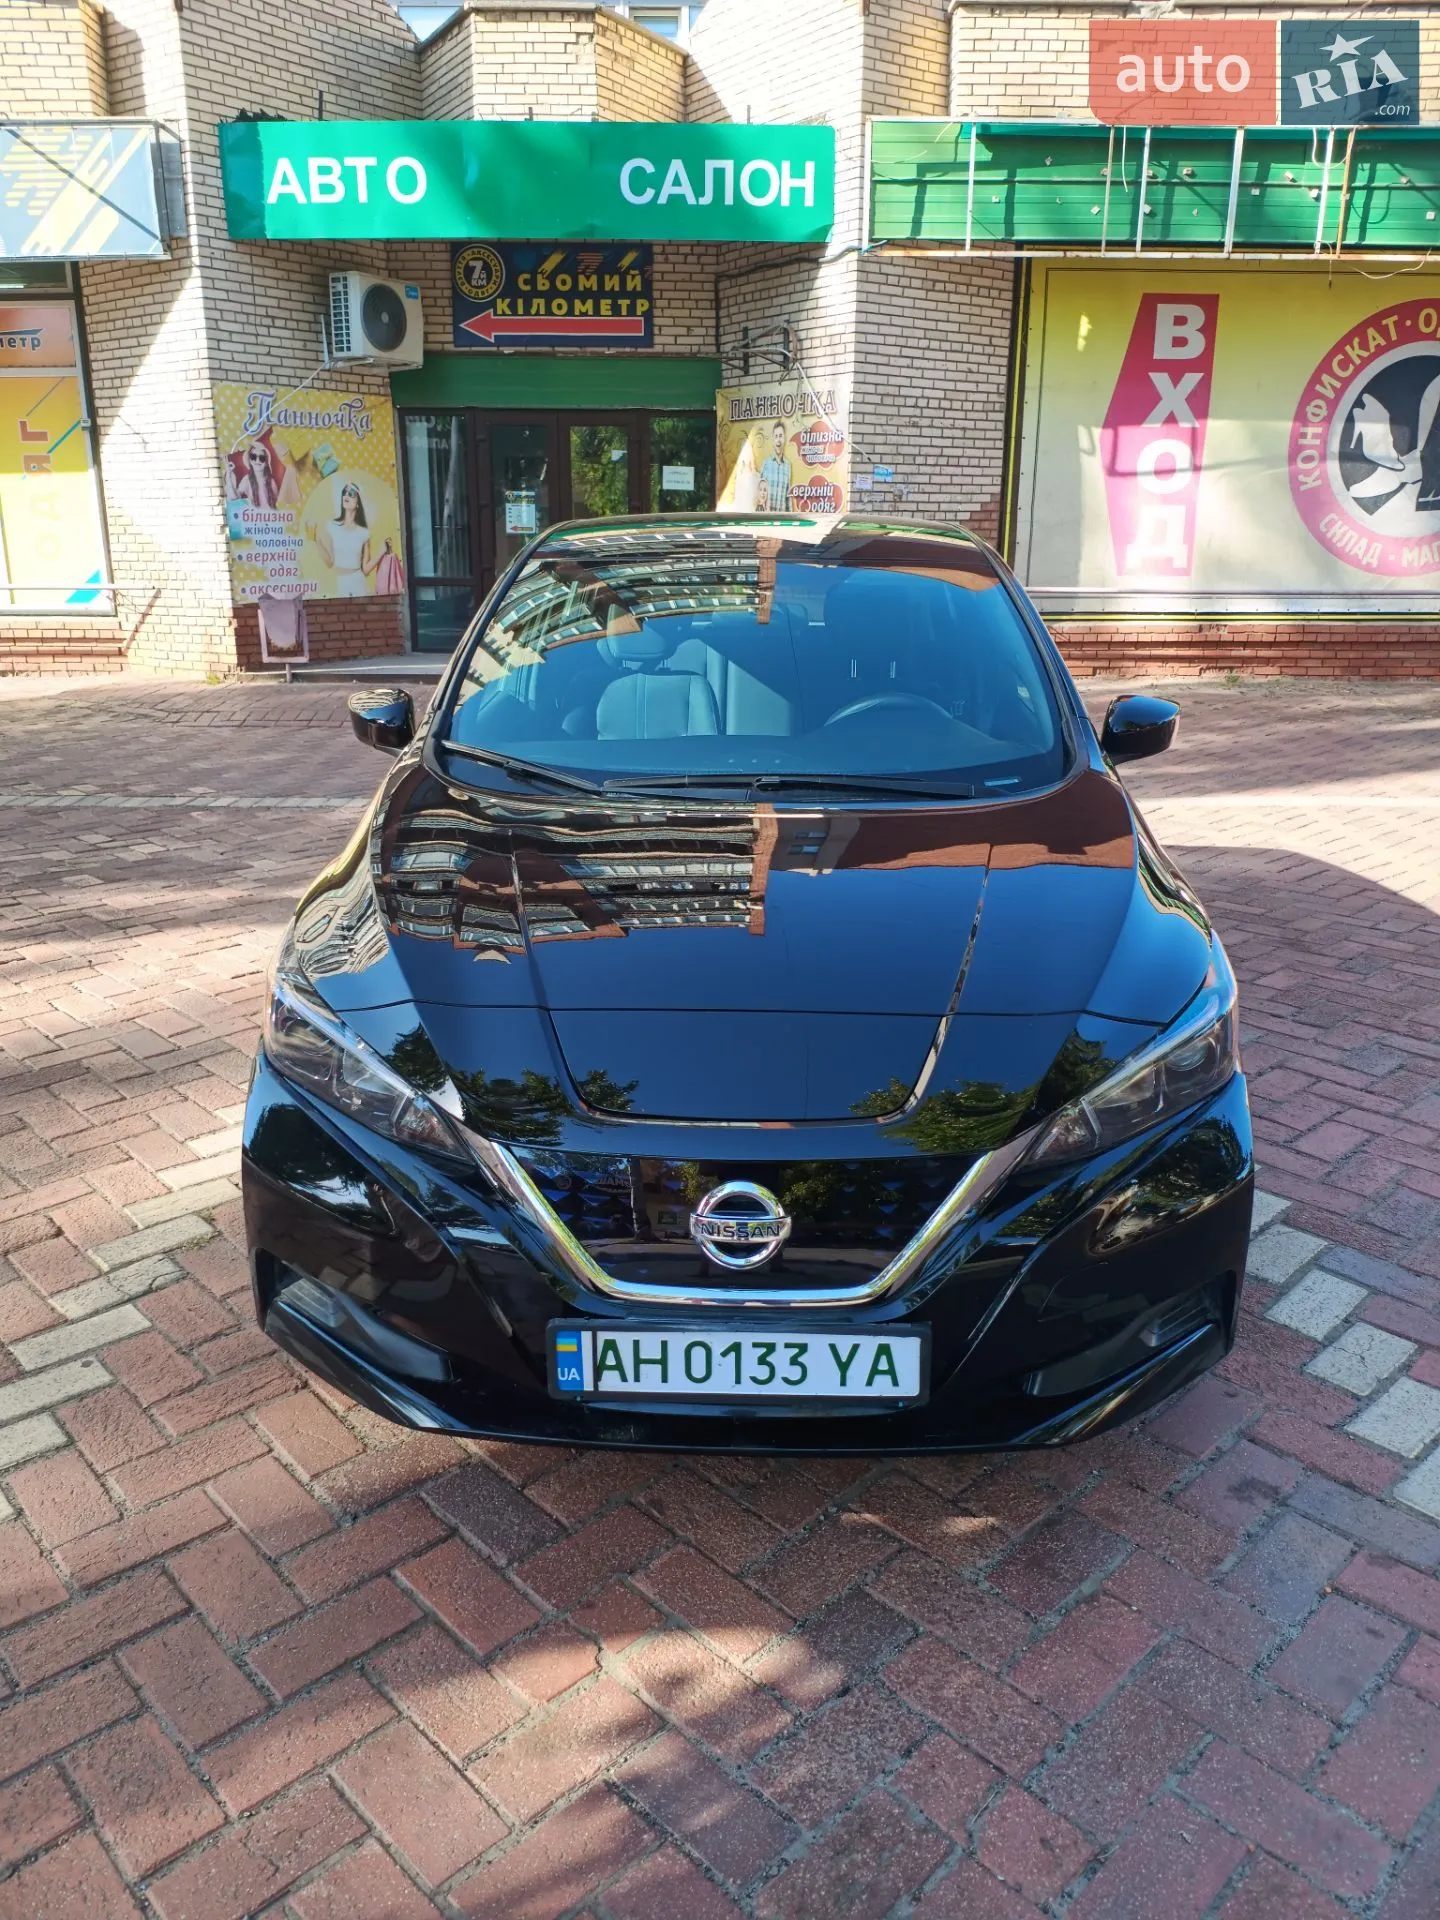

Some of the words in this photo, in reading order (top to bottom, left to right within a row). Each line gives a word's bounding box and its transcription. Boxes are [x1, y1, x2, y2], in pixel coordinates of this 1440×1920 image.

[266, 155, 428, 205] АВТО
[619, 157, 815, 207] САЛОН
[517, 270, 642, 292] СЬОМИЙ
[496, 298, 650, 316] КІЛОМЕТР
[730, 389, 836, 420] ПАННОЧКА
[1296, 314, 1399, 492] КОНФИСКАТ
[243, 390, 371, 439] Панночка
[800, 428, 842, 443] білизна
[1126, 303, 1206, 570] ВХОД
[792, 481, 834, 500] верхній
[242, 509, 294, 522] білизна
[244, 523, 284, 535] жіноча
[255, 535, 304, 547] чоловіча
[1319, 512, 1383, 568] СКЛАД
[246, 548, 297, 565] верхній
[269, 563, 299, 577] одяг
[700, 1223, 783, 1239] NISSAN
[597, 1338, 669, 1384] AH
[683, 1340, 809, 1386] 0133
[828, 1343, 901, 1388] YA
[557, 1367, 581, 1381] UA
